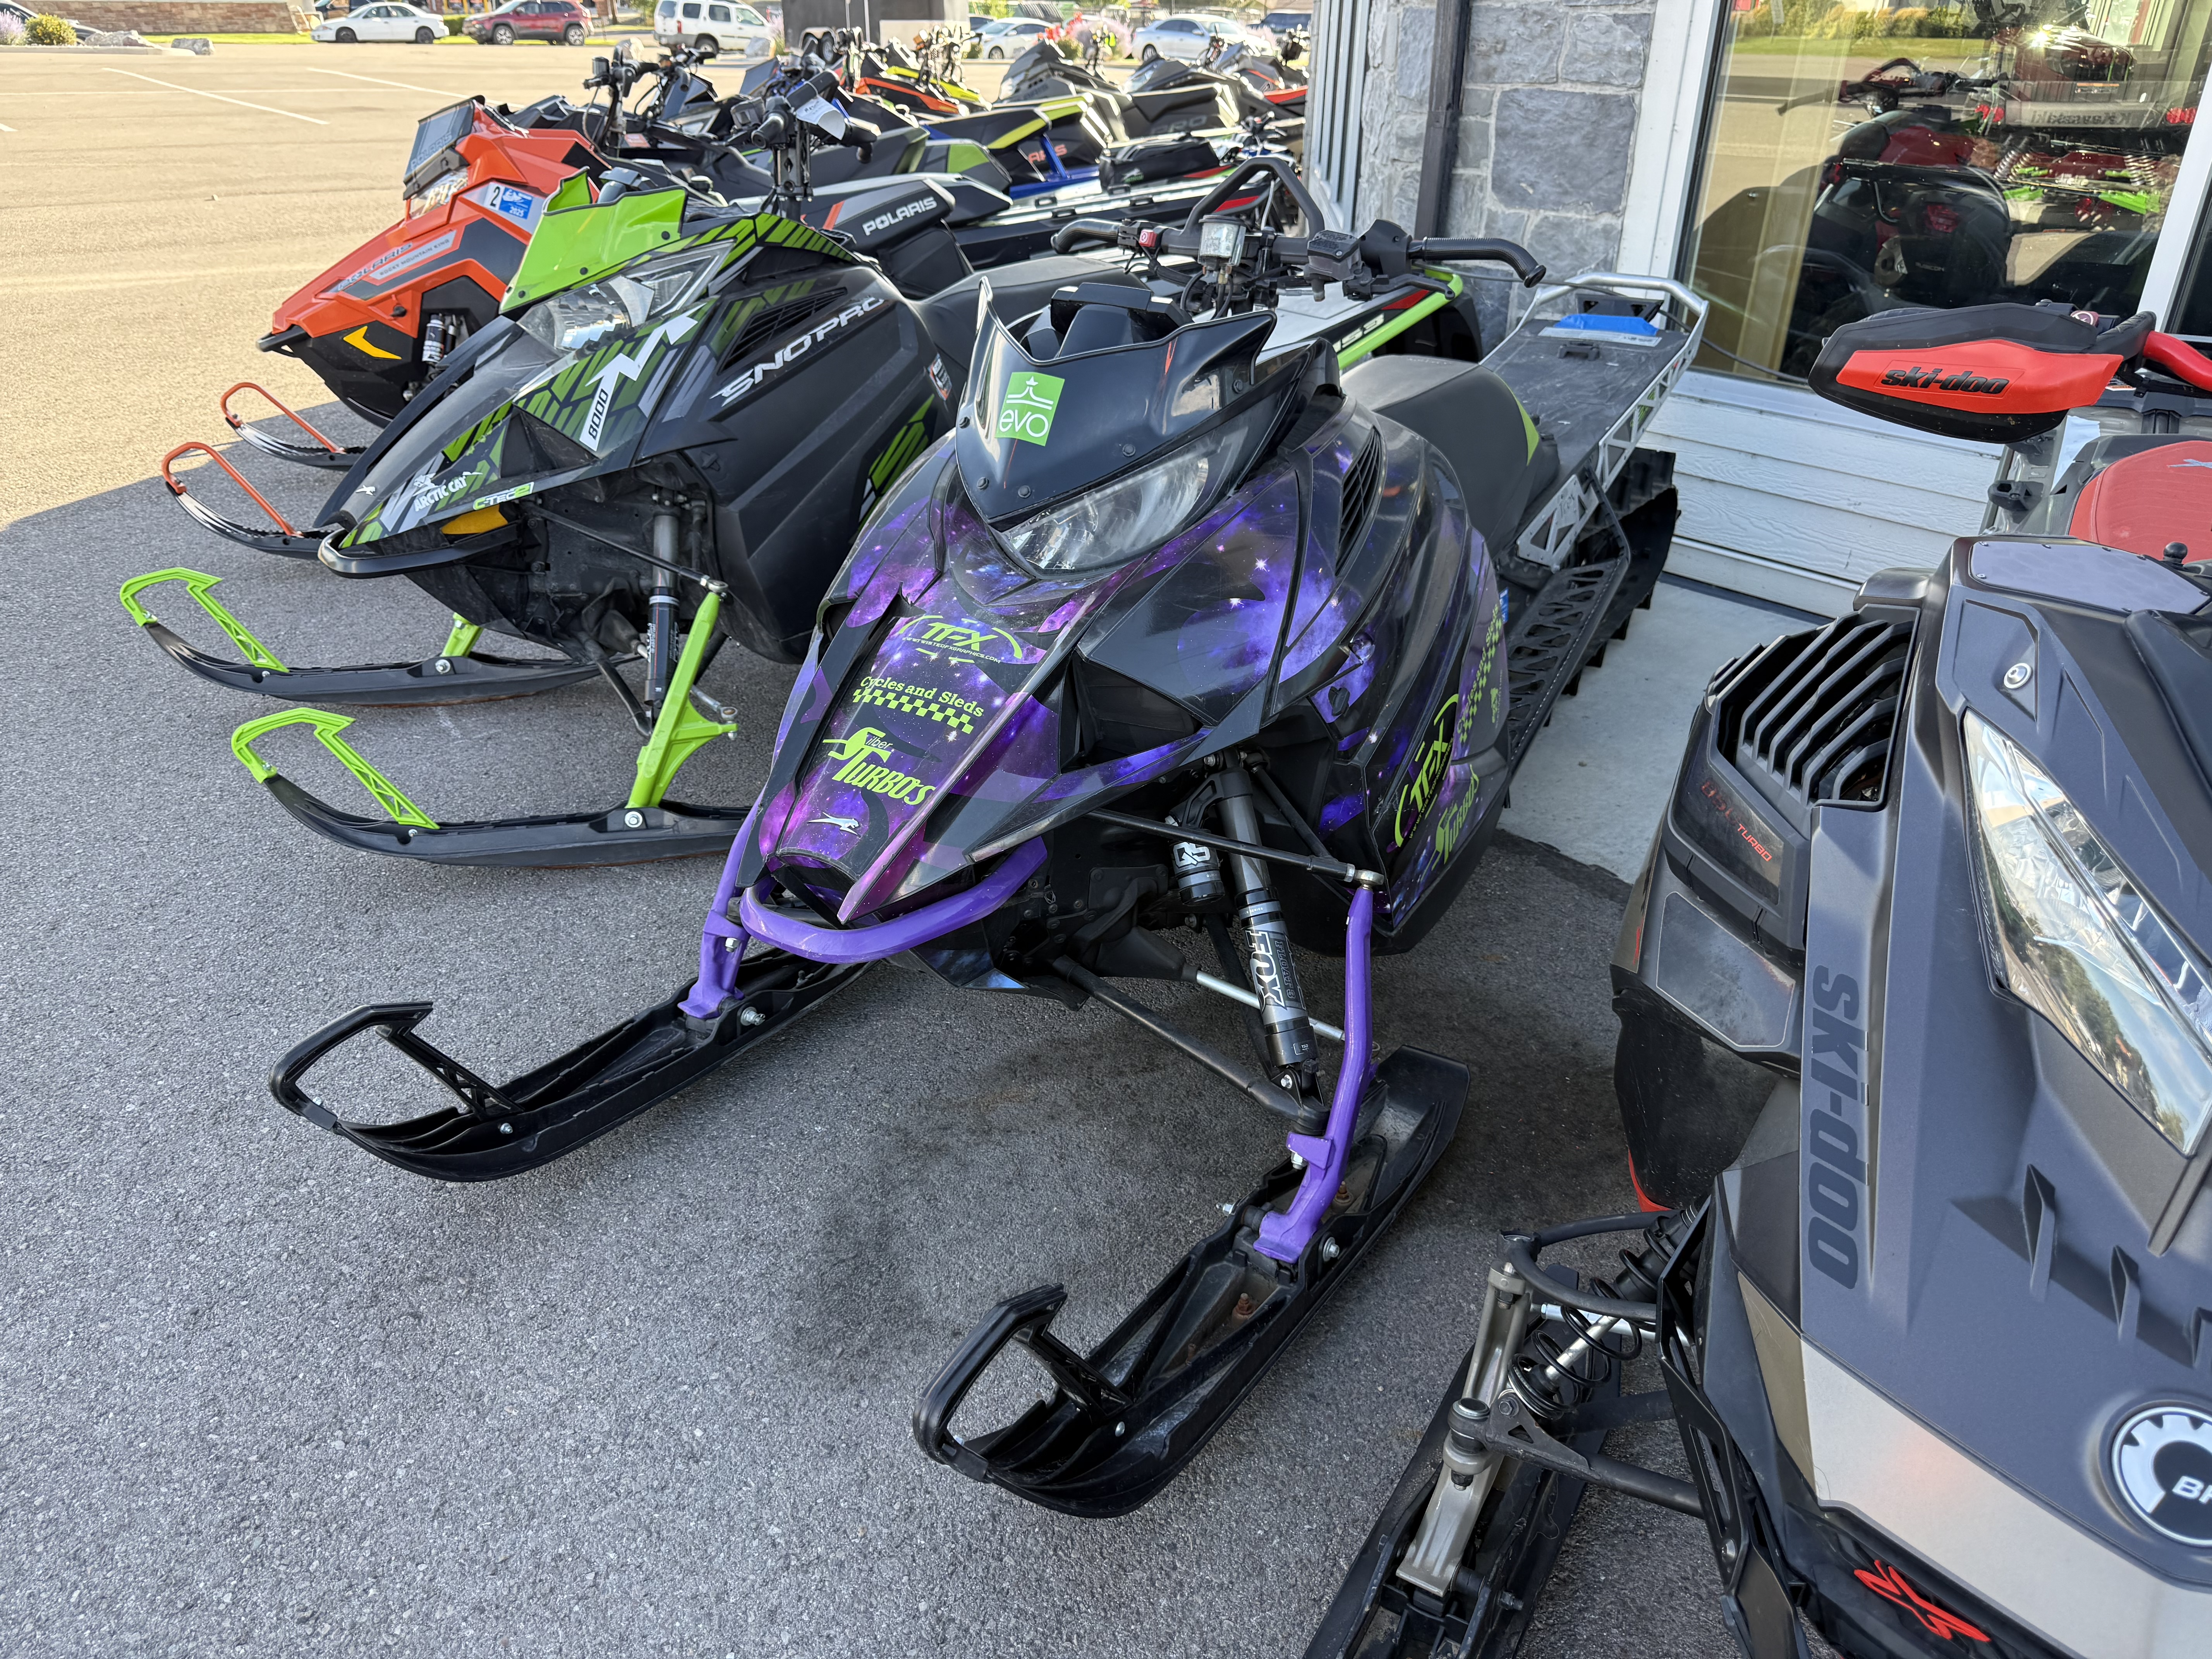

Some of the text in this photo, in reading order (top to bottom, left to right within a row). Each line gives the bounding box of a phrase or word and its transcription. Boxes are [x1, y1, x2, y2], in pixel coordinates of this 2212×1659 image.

[410, 132, 452, 170] POLARIS
[490, 186, 500, 207] 2
[862, 196, 937, 236] POLARIS
[401, 247, 433, 264] MOUNTAIN
[434, 239, 450, 249] KING
[709, 297, 885, 407] SNOPRO
[1881, 366, 2010, 395] ski-doo
[588, 388, 609, 440] 8000
[999, 409, 1049, 437] evo
[414, 476, 467, 512] ARCTIC CAT
[921, 622, 999, 651] TFX
[860, 676, 984, 717] Cycles and Sleds
[1737, 823, 1772, 862] TURBO
[1245, 930, 1287, 1012] FOX
[1274, 940, 1293, 986] FLOAT
[1286, 989, 1296, 999] 3
